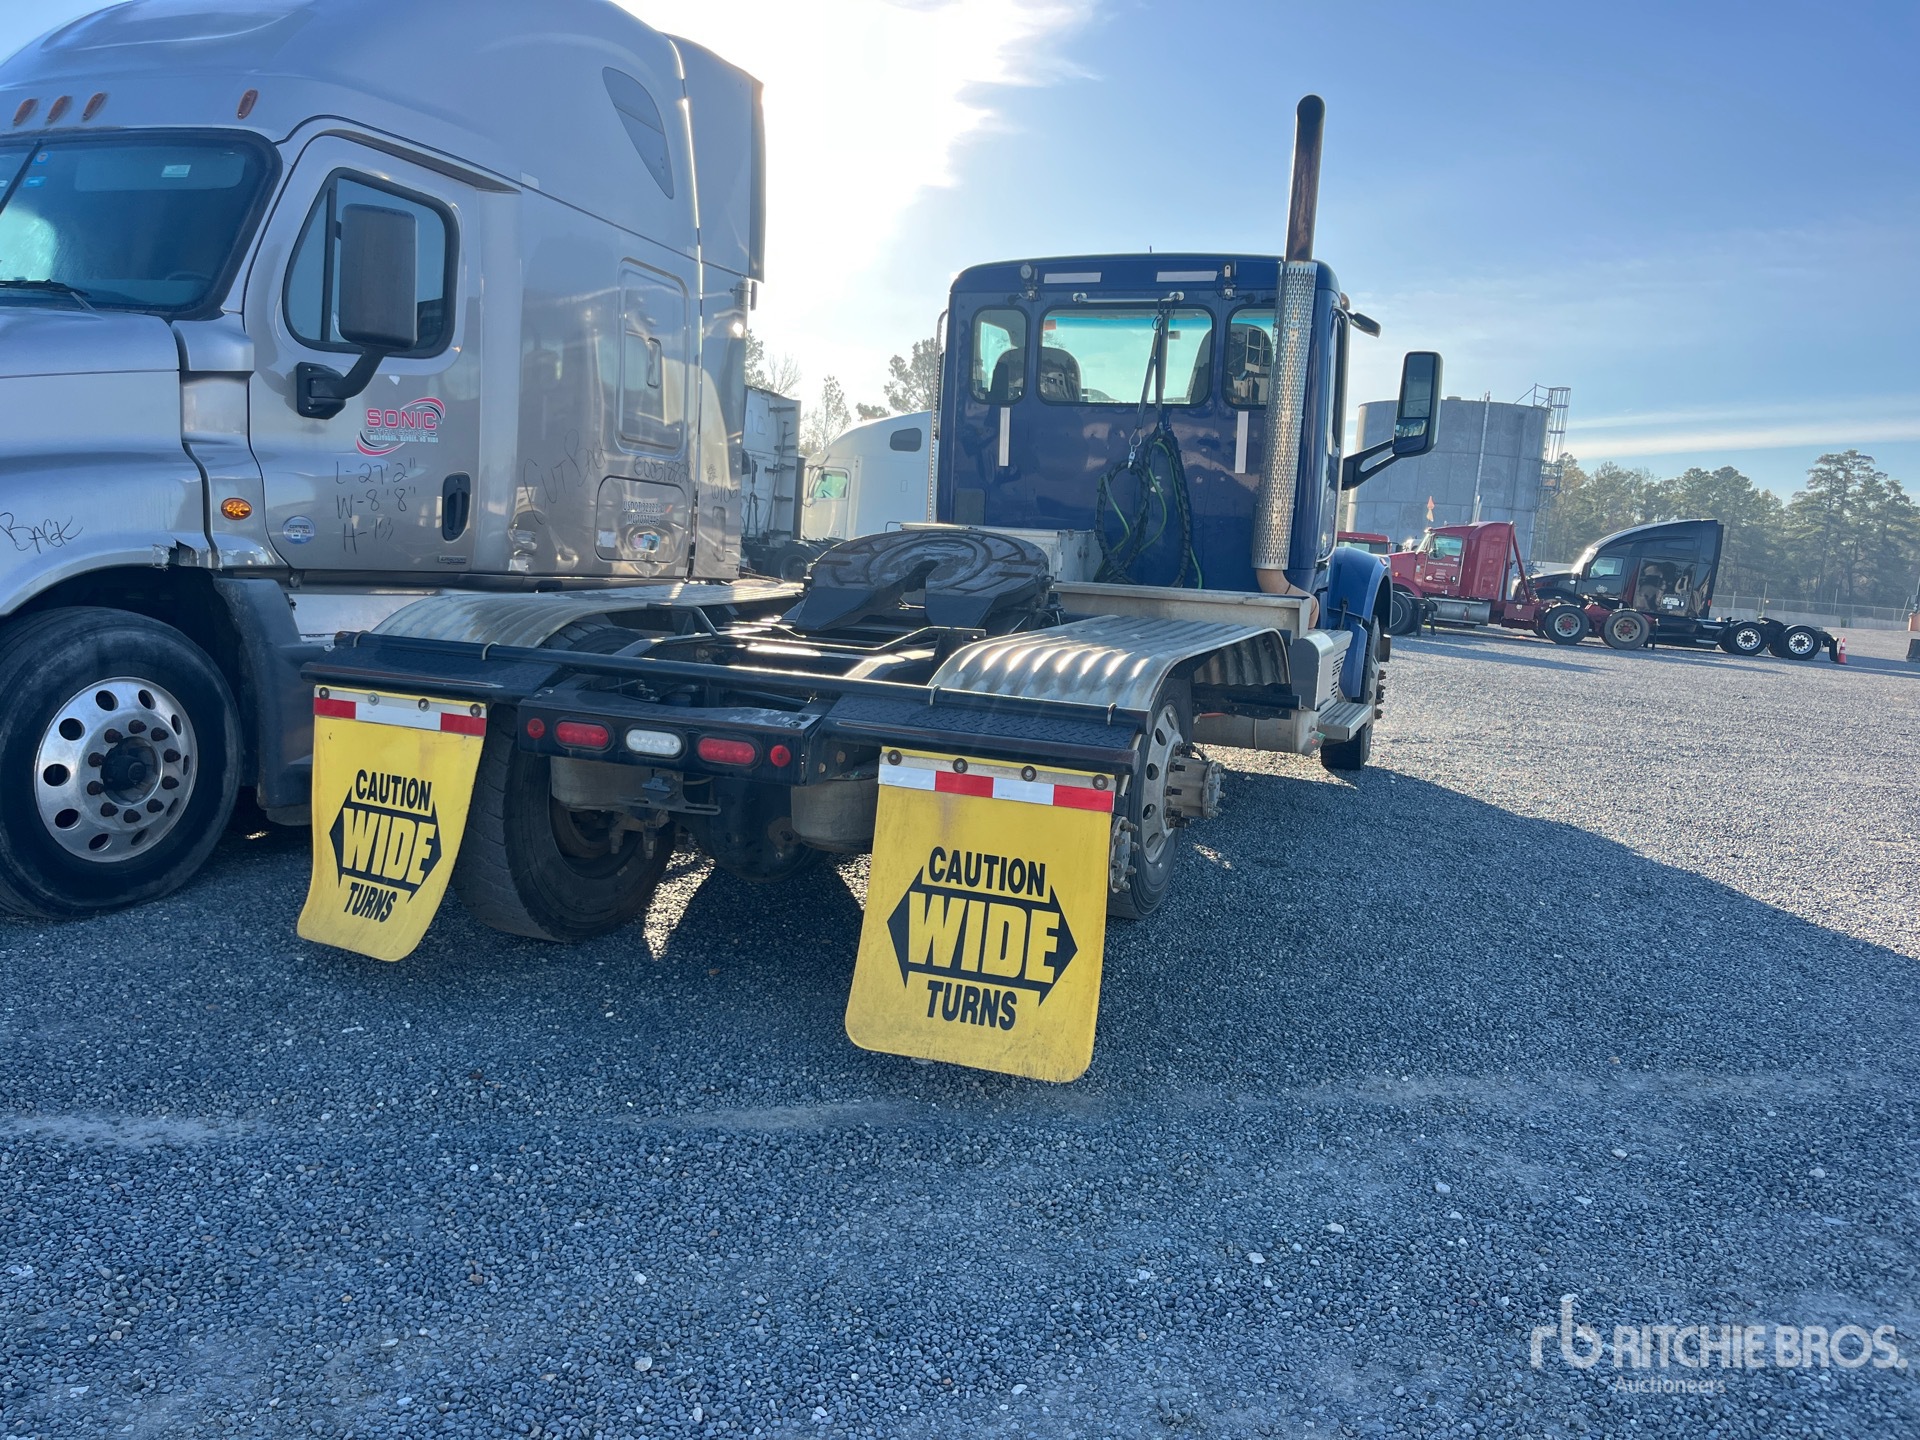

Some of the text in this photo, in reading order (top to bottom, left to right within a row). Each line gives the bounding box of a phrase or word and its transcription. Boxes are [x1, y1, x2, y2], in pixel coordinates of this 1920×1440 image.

[366, 408, 437, 431] SONIC
[355, 768, 433, 812] CAUTION
[342, 806, 437, 886] WIDE
[928, 846, 1046, 898] CAUTION
[343, 881, 398, 923] TURNS
[907, 890, 1061, 984] WIDE
[926, 979, 1018, 1031] TURNS
